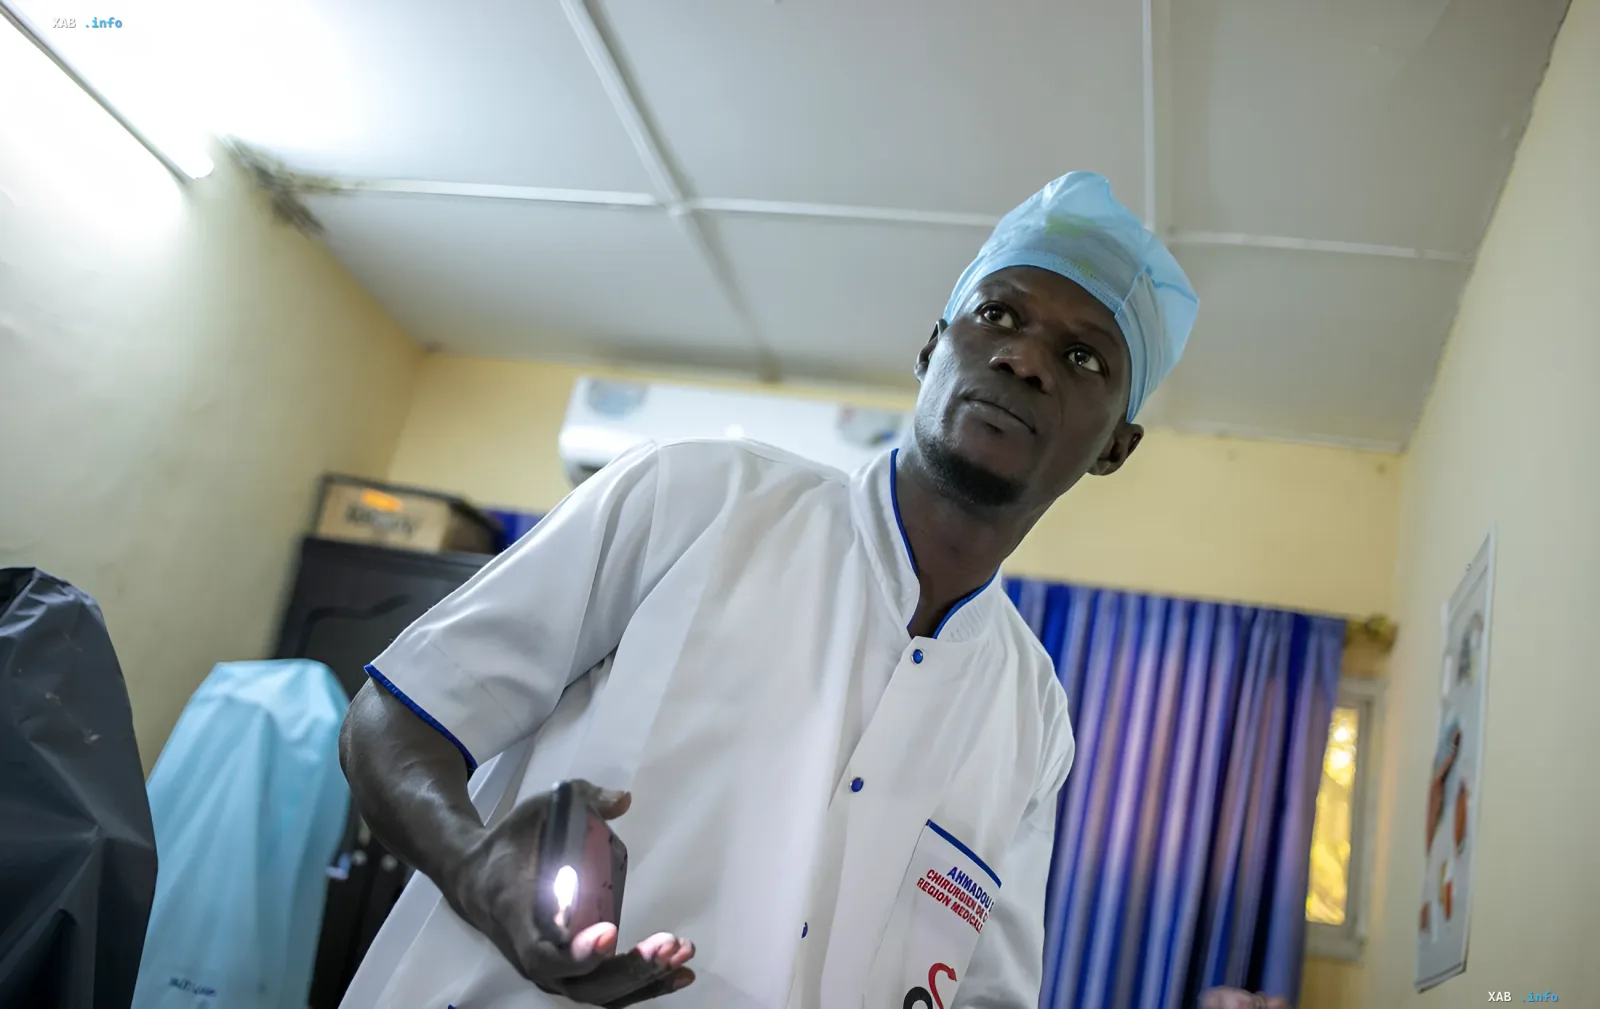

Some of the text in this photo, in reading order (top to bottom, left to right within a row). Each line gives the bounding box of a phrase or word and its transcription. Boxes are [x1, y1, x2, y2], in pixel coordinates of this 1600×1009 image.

[917, 877, 952, 907] REGION
[926, 869, 978, 910] CHIRURGIEN
[947, 866, 992, 909] AHMADOU
